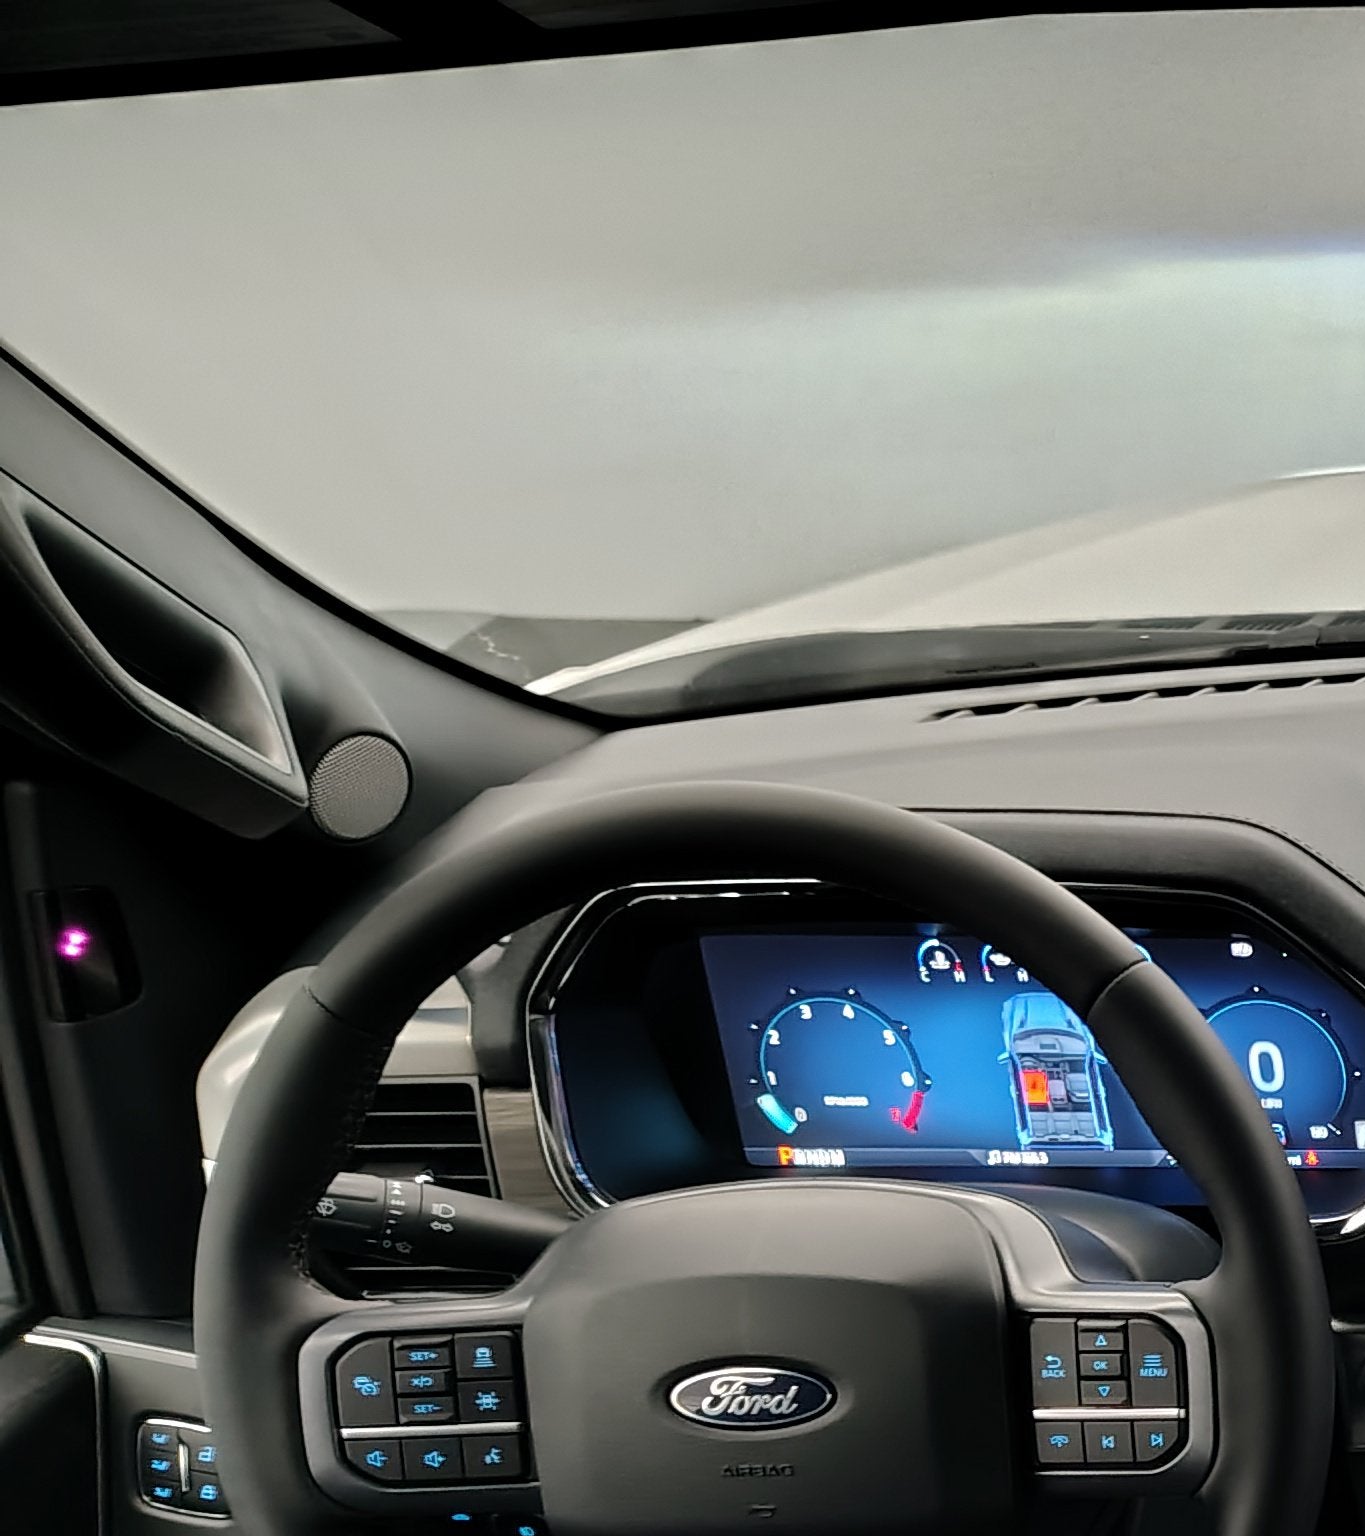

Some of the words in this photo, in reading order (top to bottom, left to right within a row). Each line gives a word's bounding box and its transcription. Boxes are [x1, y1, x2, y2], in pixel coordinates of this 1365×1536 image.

[800, 1004, 812, 1019] 3
[843, 1004, 855, 1019] 4
[768, 1029, 780, 1045] 2
[883, 1029, 896, 1046] 5
[1248, 1040, 1285, 1093] 0
[767, 1071, 778, 1086] 1
[1092, 1360, 1109, 1371] OK
[1139, 1367, 1169, 1378] MENU
[1040, 1368, 1067, 1379] BACK
[701, 1375, 799, 1416] Ford
